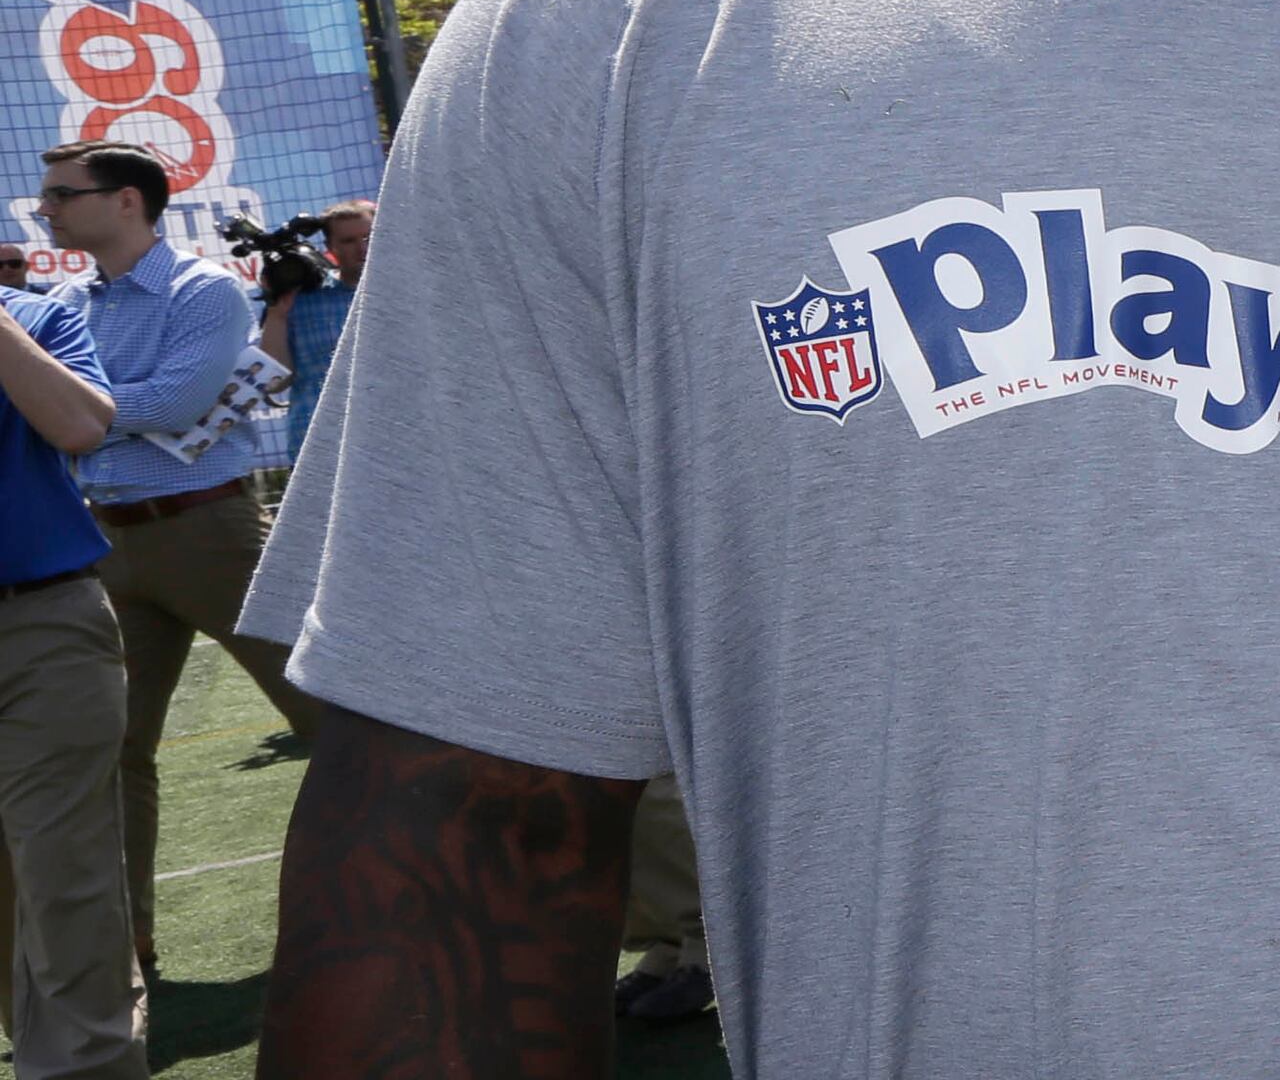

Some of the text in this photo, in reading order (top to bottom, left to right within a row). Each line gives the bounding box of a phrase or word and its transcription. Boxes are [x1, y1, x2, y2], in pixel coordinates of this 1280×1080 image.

[778, 337, 873, 403] NFL
[935, 363, 1179, 417] THE NFL MOVEMENT
